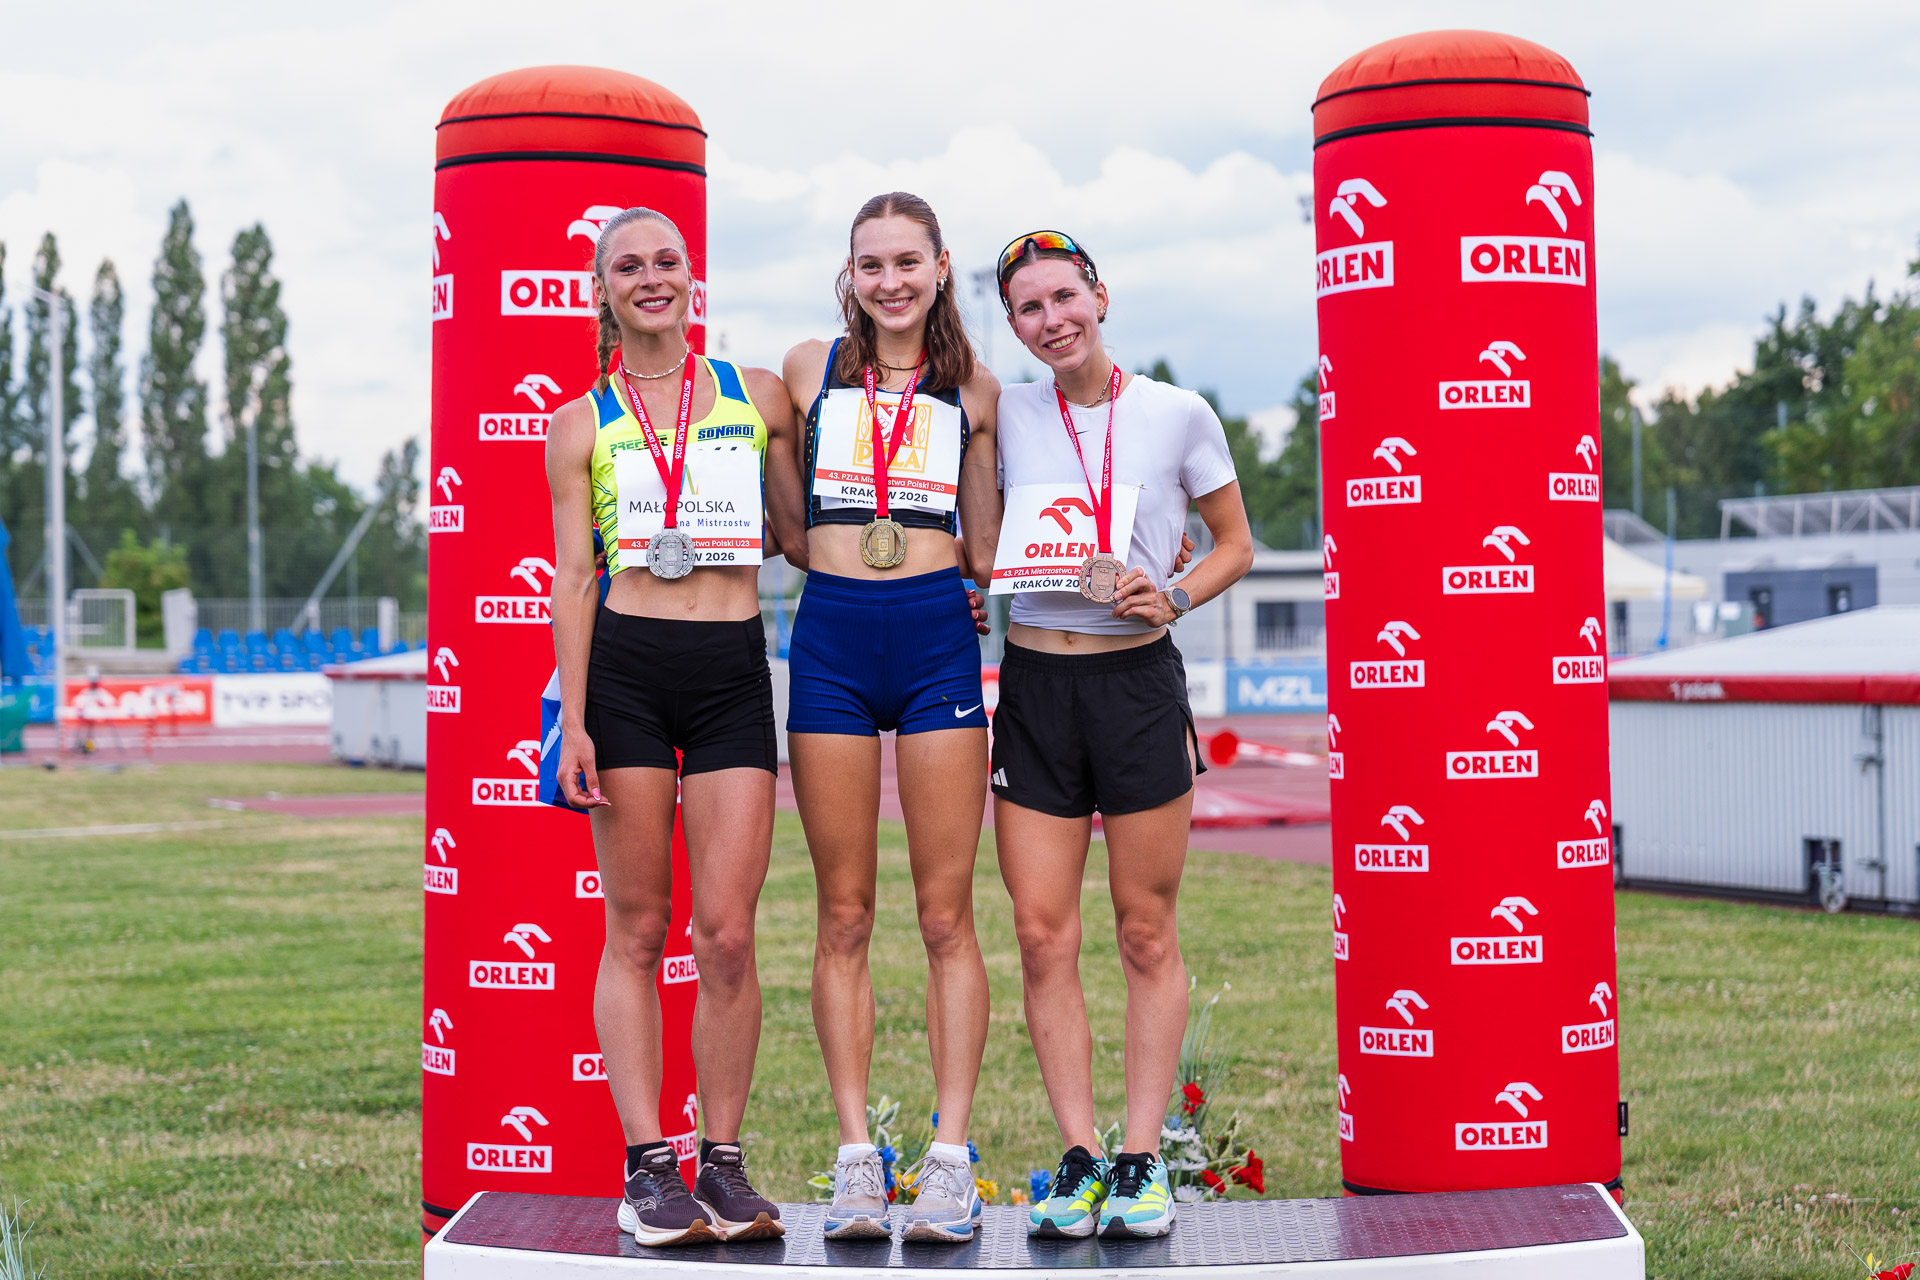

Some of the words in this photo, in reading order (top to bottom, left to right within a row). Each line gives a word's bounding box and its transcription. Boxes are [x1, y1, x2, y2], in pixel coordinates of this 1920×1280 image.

[1470, 243, 1581, 278] ORLEN
[509, 277, 592, 309] ORL
[680, 379, 692, 421] MISTRZOSTWA
[1445, 385, 1524, 404] ORLEN
[642, 422, 655, 445] POLSKI
[651, 442, 662, 458] 2026
[677, 421, 686, 445] POLSKI
[697, 425, 756, 441] SONAROL
[674, 444, 684, 460] 2026
[856, 444, 921, 469] PLA
[828, 472, 840, 480] 43.
[841, 473, 859, 482] PZLA
[907, 480, 929, 490] Polski
[931, 484, 945, 492] U23
[1350, 480, 1415, 502] ORLEN
[1553, 478, 1597, 498] ORLEN
[898, 491, 929, 503] 2026
[697, 518, 751, 527] Mistrzostw
[631, 540, 643, 548] 43.
[711, 539, 734, 548] Polski
[1024, 543, 1096, 559] ORLEN
[705, 552, 736, 562] 2026
[1013, 568, 1030, 576] PZLA
[1030, 567, 1073, 575] Mistrzostwa
[1448, 570, 1528, 590] ORLEN
[1012, 576, 1064, 590] KRAKÓW
[1354, 665, 1418, 684] ORLEN
[1557, 660, 1602, 679] ORLEN
[1452, 755, 1532, 775] ORLEN
[477, 782, 540, 801] ORLE
[1359, 848, 1423, 868] ORLEN
[1561, 842, 1608, 864] ORLEN
[1456, 940, 1537, 961] ORLEN
[474, 965, 548, 985] ORLEN
[667, 959, 697, 979] ORLE
[1363, 1031, 1427, 1052] ORLEN
[1565, 1023, 1612, 1048] ORLEN
[1461, 1125, 1542, 1147] ORLEN
[471, 1147, 546, 1169] ORLEN
